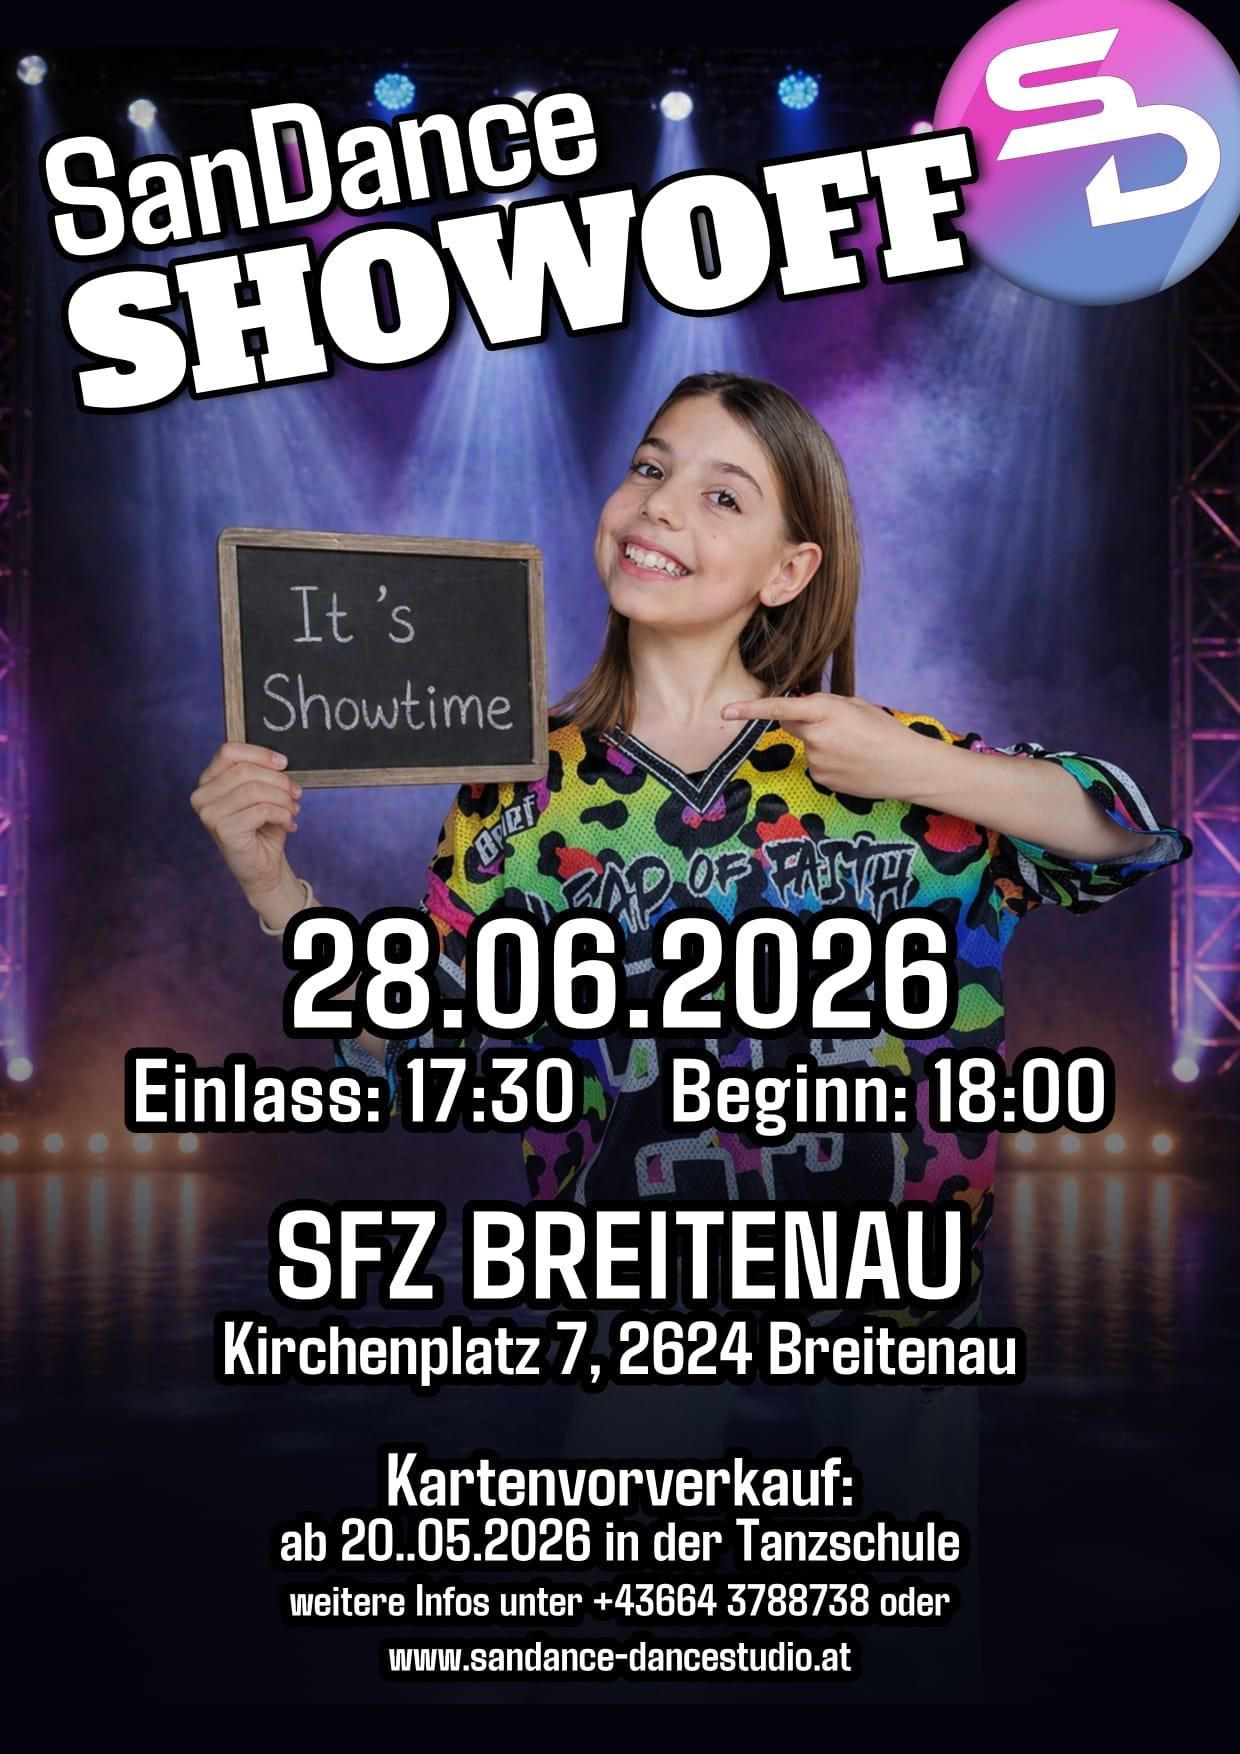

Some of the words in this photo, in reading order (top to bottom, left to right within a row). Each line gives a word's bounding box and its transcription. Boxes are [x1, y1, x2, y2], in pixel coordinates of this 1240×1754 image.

[986, 28, 1222, 227] SD
[46, 92, 597, 255] SanDance
[68, 133, 972, 408] SHOWOFF
[263, 673, 512, 731] Showtime
[686, 848, 751, 897] OF
[293, 917, 948, 1030] 28.06.2026
[135, 1058, 379, 1123] Einlass:
[407, 1057, 573, 1123] 17:30
[673, 1058, 906, 1137] Beginn:
[934, 1057, 1105, 1123] 18:00
[278, 1209, 436, 1300] SFZ
[473, 1210, 961, 1300] BREITENAU
[224, 1321, 540, 1387] Kirchenplatz
[556, 1321, 601, 1384] 7,
[619, 1320, 753, 1375] 2624
[770, 1321, 1016, 1375] Breitenau
[388, 1452, 853, 1507] Kartenvorverkauf:
[280, 1522, 327, 1562] ab
[341, 1517, 591, 1562] 20..05.2026
[606, 1522, 639, 1561] in
[653, 1522, 723, 1562] der
[735, 1518, 960, 1562] Tanzschule
[289, 1586, 405, 1617] weitere
[416, 1583, 490, 1617] Infos
[500, 1587, 583, 1617] unter
[593, 1583, 718, 1617] +43664
[727, 1583, 870, 1617] 3788738
[880, 1586, 950, 1617] oder
[388, 1641, 852, 1672] www.sandance-dancestudio.at
